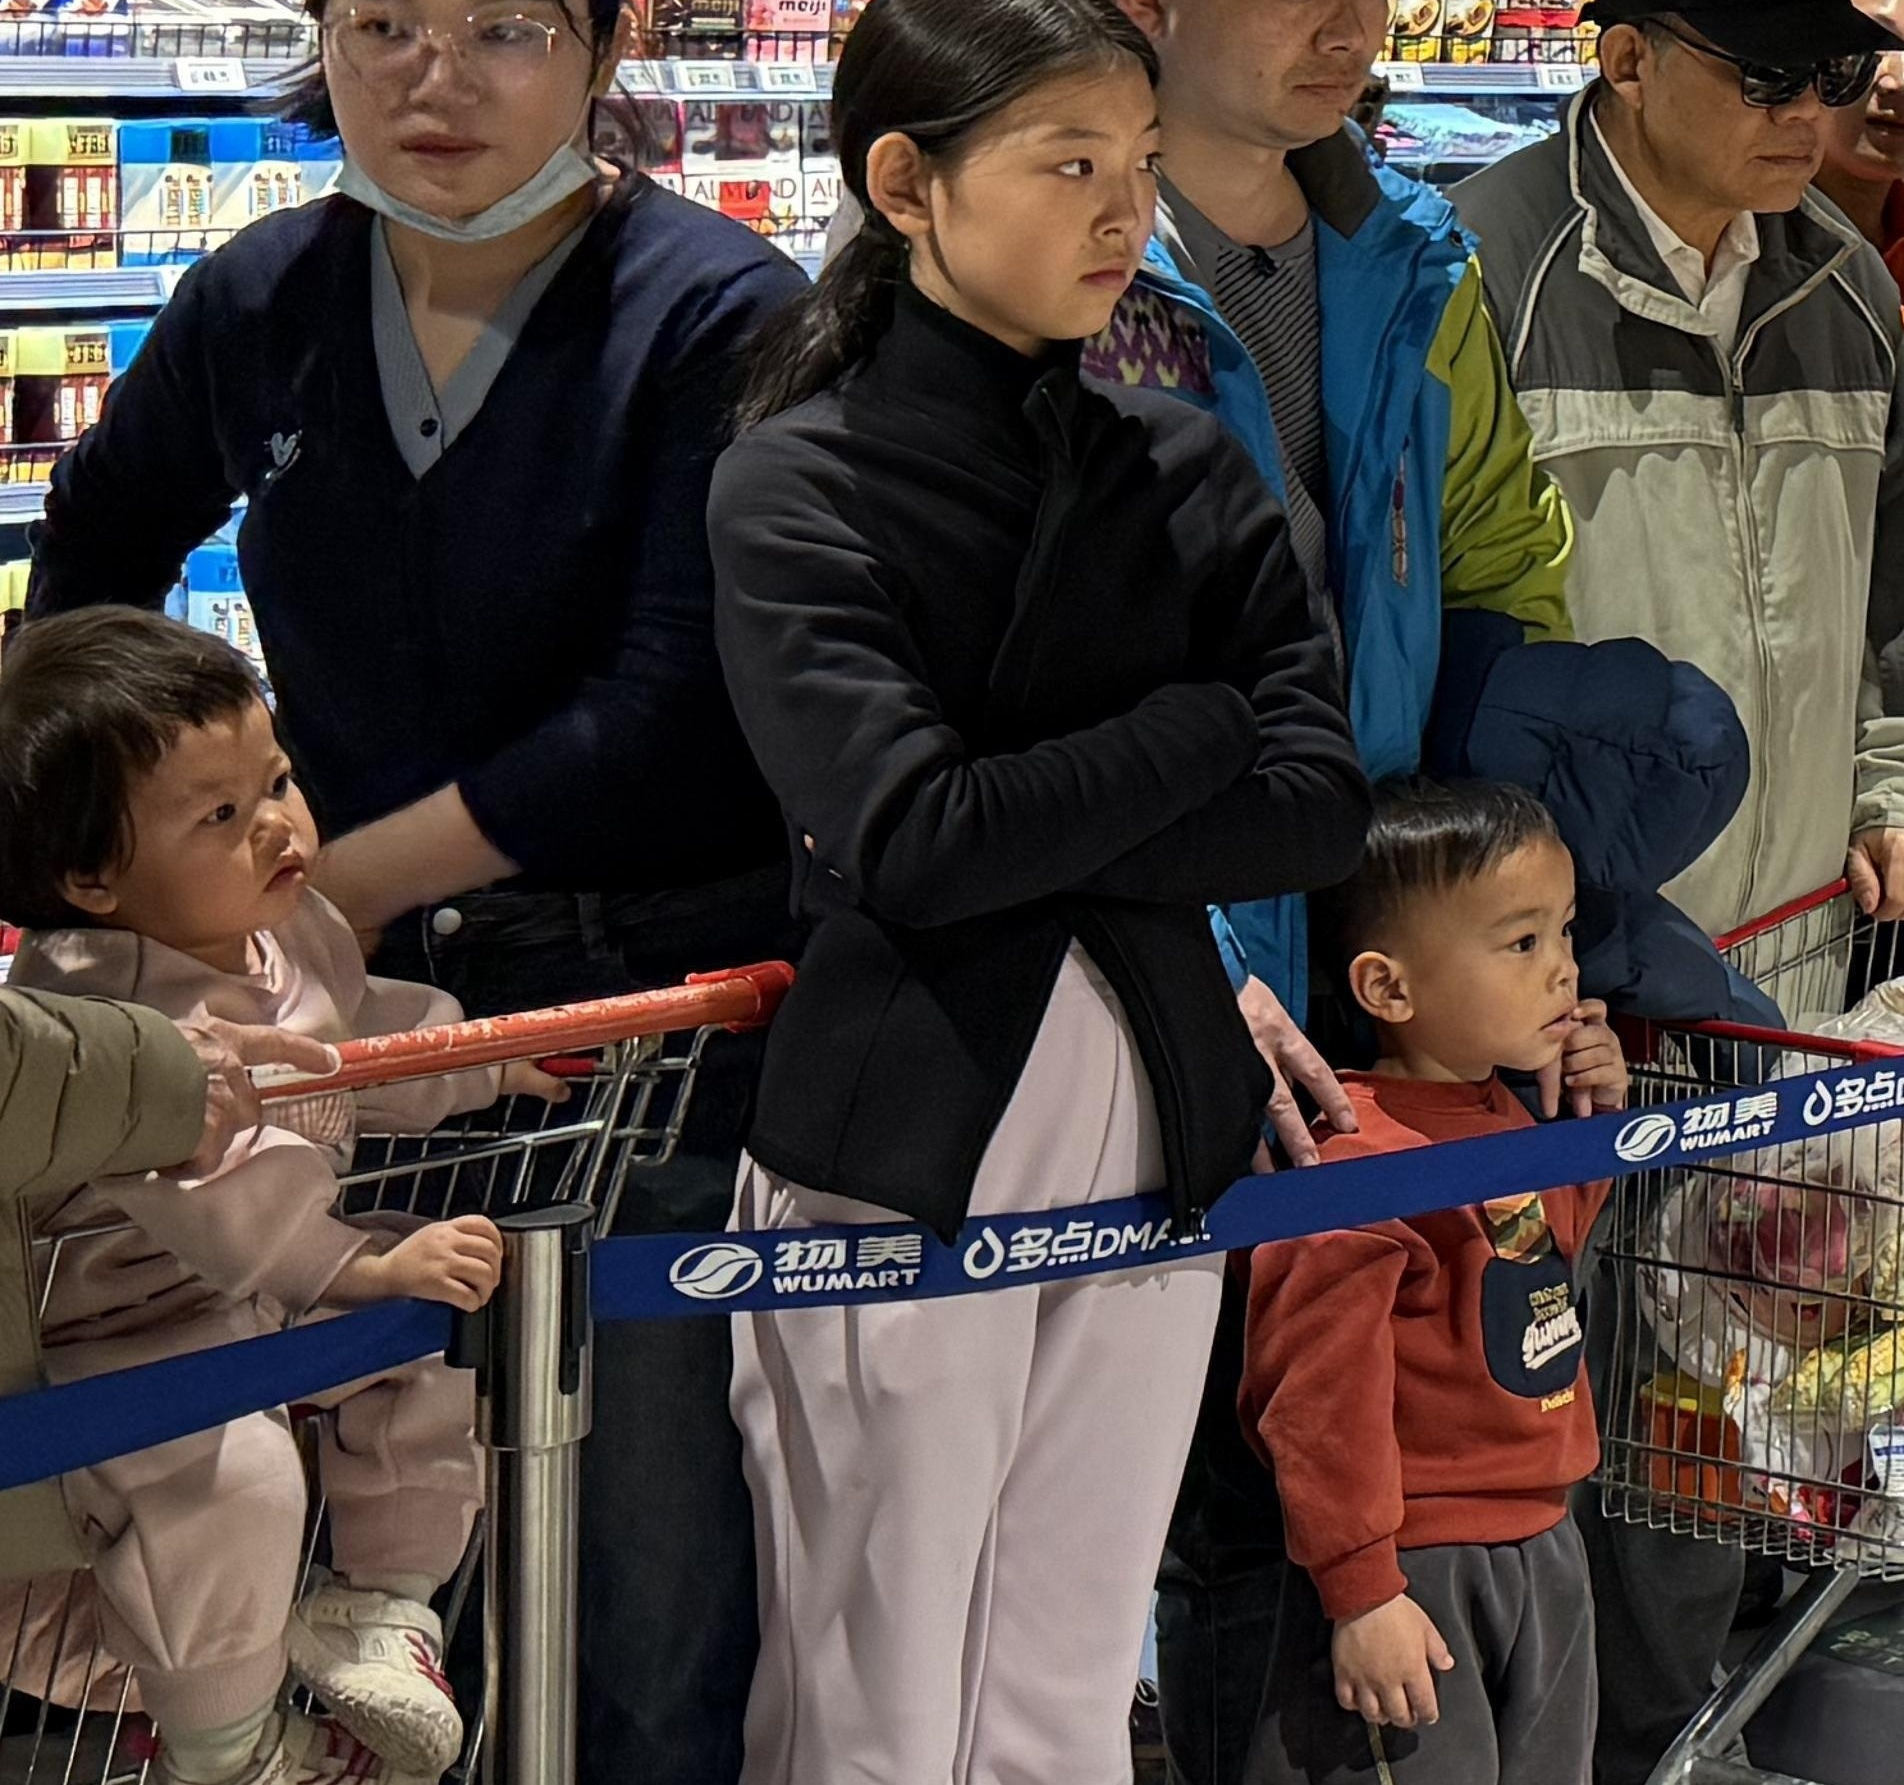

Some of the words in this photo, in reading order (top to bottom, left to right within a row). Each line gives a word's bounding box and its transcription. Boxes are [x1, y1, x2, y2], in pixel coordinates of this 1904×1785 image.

[1682, 1091, 1778, 1136] 物美
[1679, 1120, 1774, 1153] WUMART
[774, 1233, 923, 1272] 物美
[1006, 1213, 1213, 1273] 多点DMA
[772, 1268, 921, 1294] WUMART
